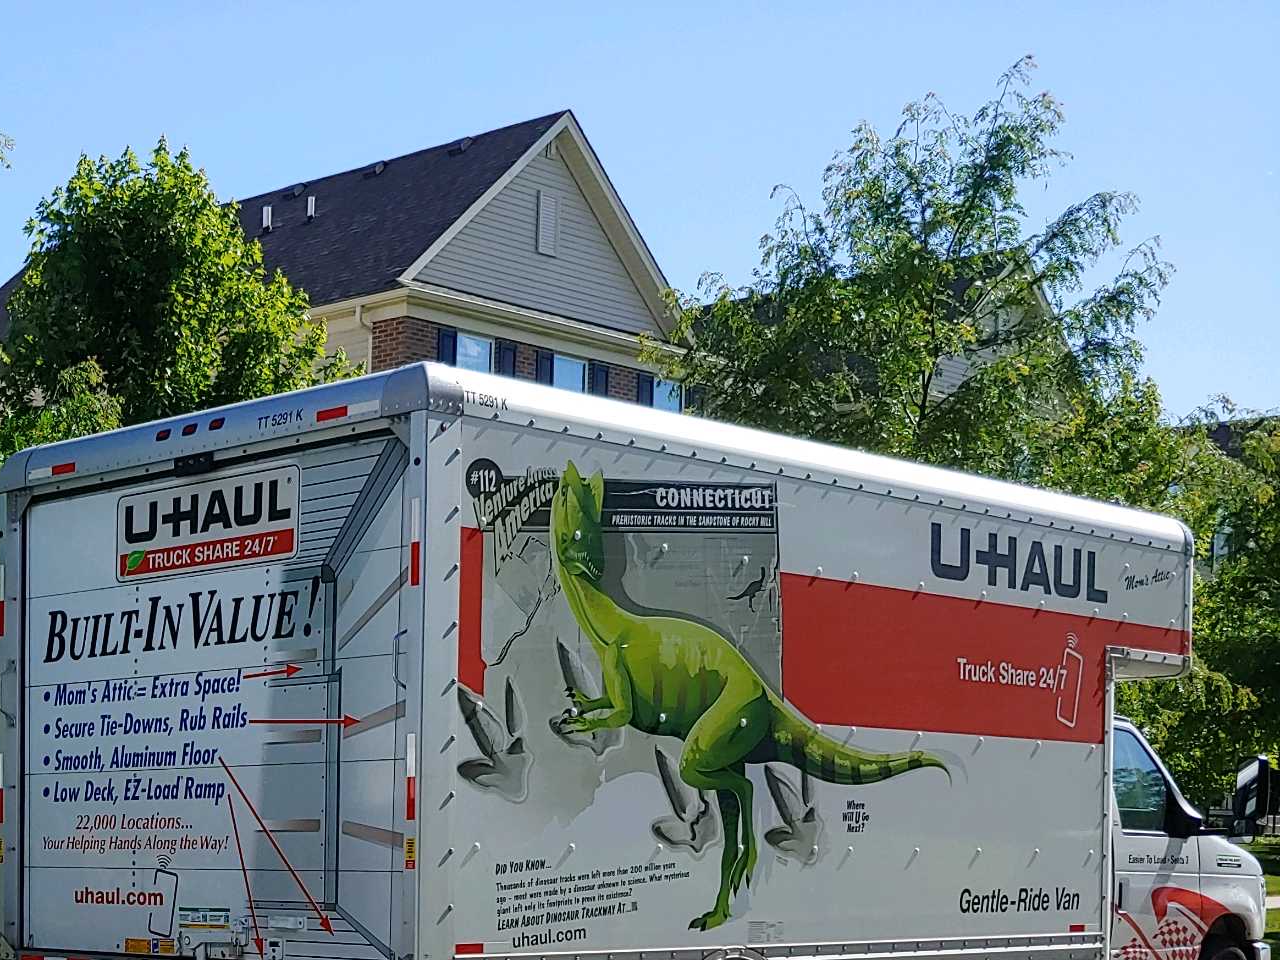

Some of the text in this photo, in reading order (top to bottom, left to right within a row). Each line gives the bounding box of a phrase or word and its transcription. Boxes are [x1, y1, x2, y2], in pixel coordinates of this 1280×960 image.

[464, 391, 509, 411] TT 5291 K
[258, 409, 303, 429] TT 5291 K
[470, 469, 497, 492] #112
[656, 487, 771, 509] CONNECTICUT
[124, 479, 292, 544] U-HAUL
[611, 514, 652, 526] PREHISTORIC
[653, 514, 676, 526] TRACKS
[686, 515, 697, 526] THE
[698, 515, 730, 527] SANDSTONE
[732, 516, 739, 527] OF
[741, 516, 759, 527] ROCKY
[147, 536, 275, 569] TRUCK SHARE 24/7
[930, 521, 1109, 604] U-HAUL
[957, 657, 1067, 693] Truck Share 24/7
[54, 681, 97, 706] Mom's
[151, 676, 189, 699] Extra
[194, 667, 242, 702] Space!
[54, 703, 248, 739] Secure Tie-Downs, Rub Rails
[54, 741, 219, 772] Smooth, Aluminum Floor
[53, 776, 225, 805] Low Deck, EZ-Load Ramp
[847, 800, 865, 810] Where
[76, 814, 117, 833] 22,000
[43, 835, 230, 855] Your Helping Hands Along the Way!
[496, 863, 507, 875] DID
[510, 861, 523, 873] YOU
[630, 865, 642, 874] 200
[74, 886, 164, 907] uhaul.com
[959, 887, 1080, 914] Gentle-Ride Van
[497, 917, 520, 931] LEARN
[521, 914, 544, 927] ABOUT
[546, 909, 579, 924] DINOSAUR
[512, 927, 586, 949] uhaul.com
